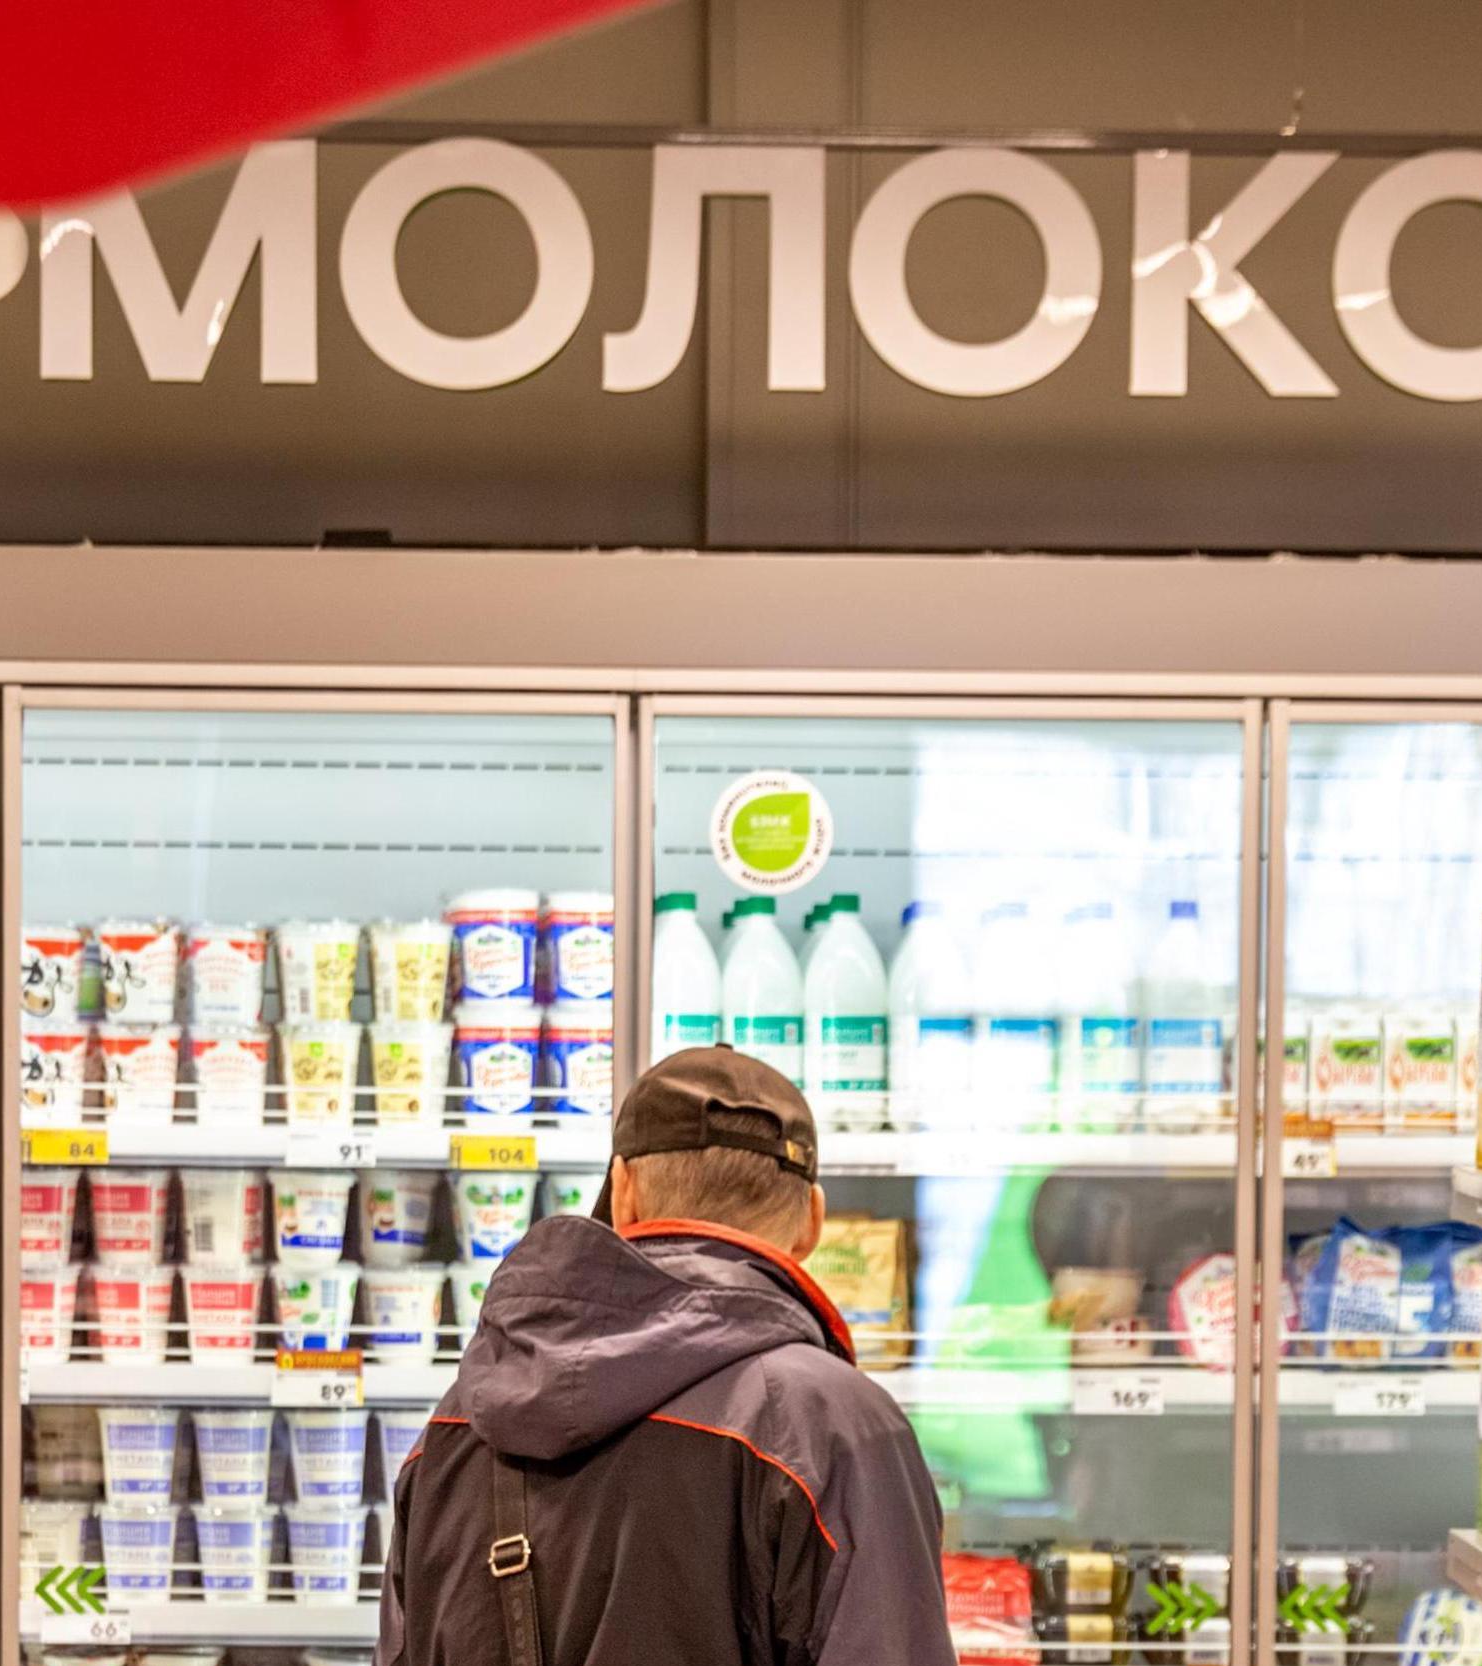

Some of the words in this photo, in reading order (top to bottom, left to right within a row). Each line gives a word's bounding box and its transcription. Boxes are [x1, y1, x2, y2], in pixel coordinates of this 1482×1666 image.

[68, 1142, 96, 1159] 84
[339, 1143, 364, 1161] 91
[487, 1147, 525, 1163] 104
[320, 1384, 346, 1401] 89
